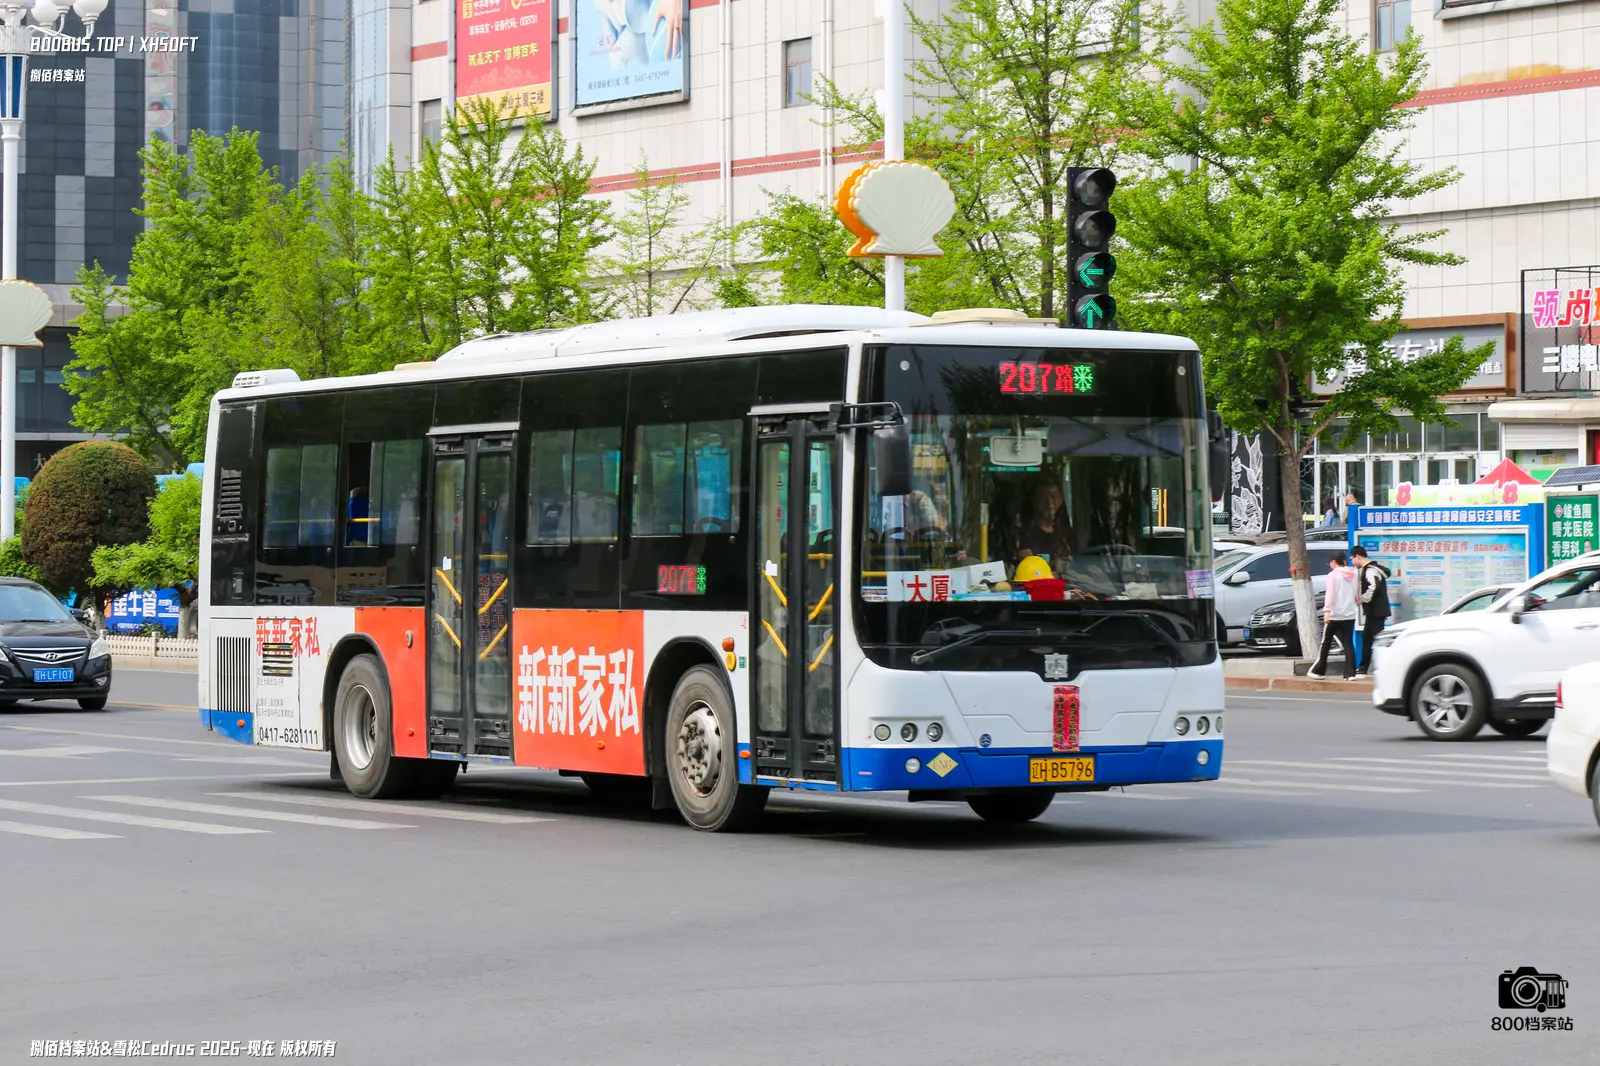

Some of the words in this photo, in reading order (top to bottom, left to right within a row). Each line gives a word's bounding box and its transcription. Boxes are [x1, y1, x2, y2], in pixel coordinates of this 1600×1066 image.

[1533, 286, 1600, 328] 领尚
[999, 362, 1075, 393] 207路
[1552, 520, 1594, 538] 曙光医院
[1552, 540, 1580, 558] 看男科
[256, 615, 321, 658] 新新家私
[518, 645, 640, 738] 新新家私
[259, 726, 319, 745] 0417-6281111
